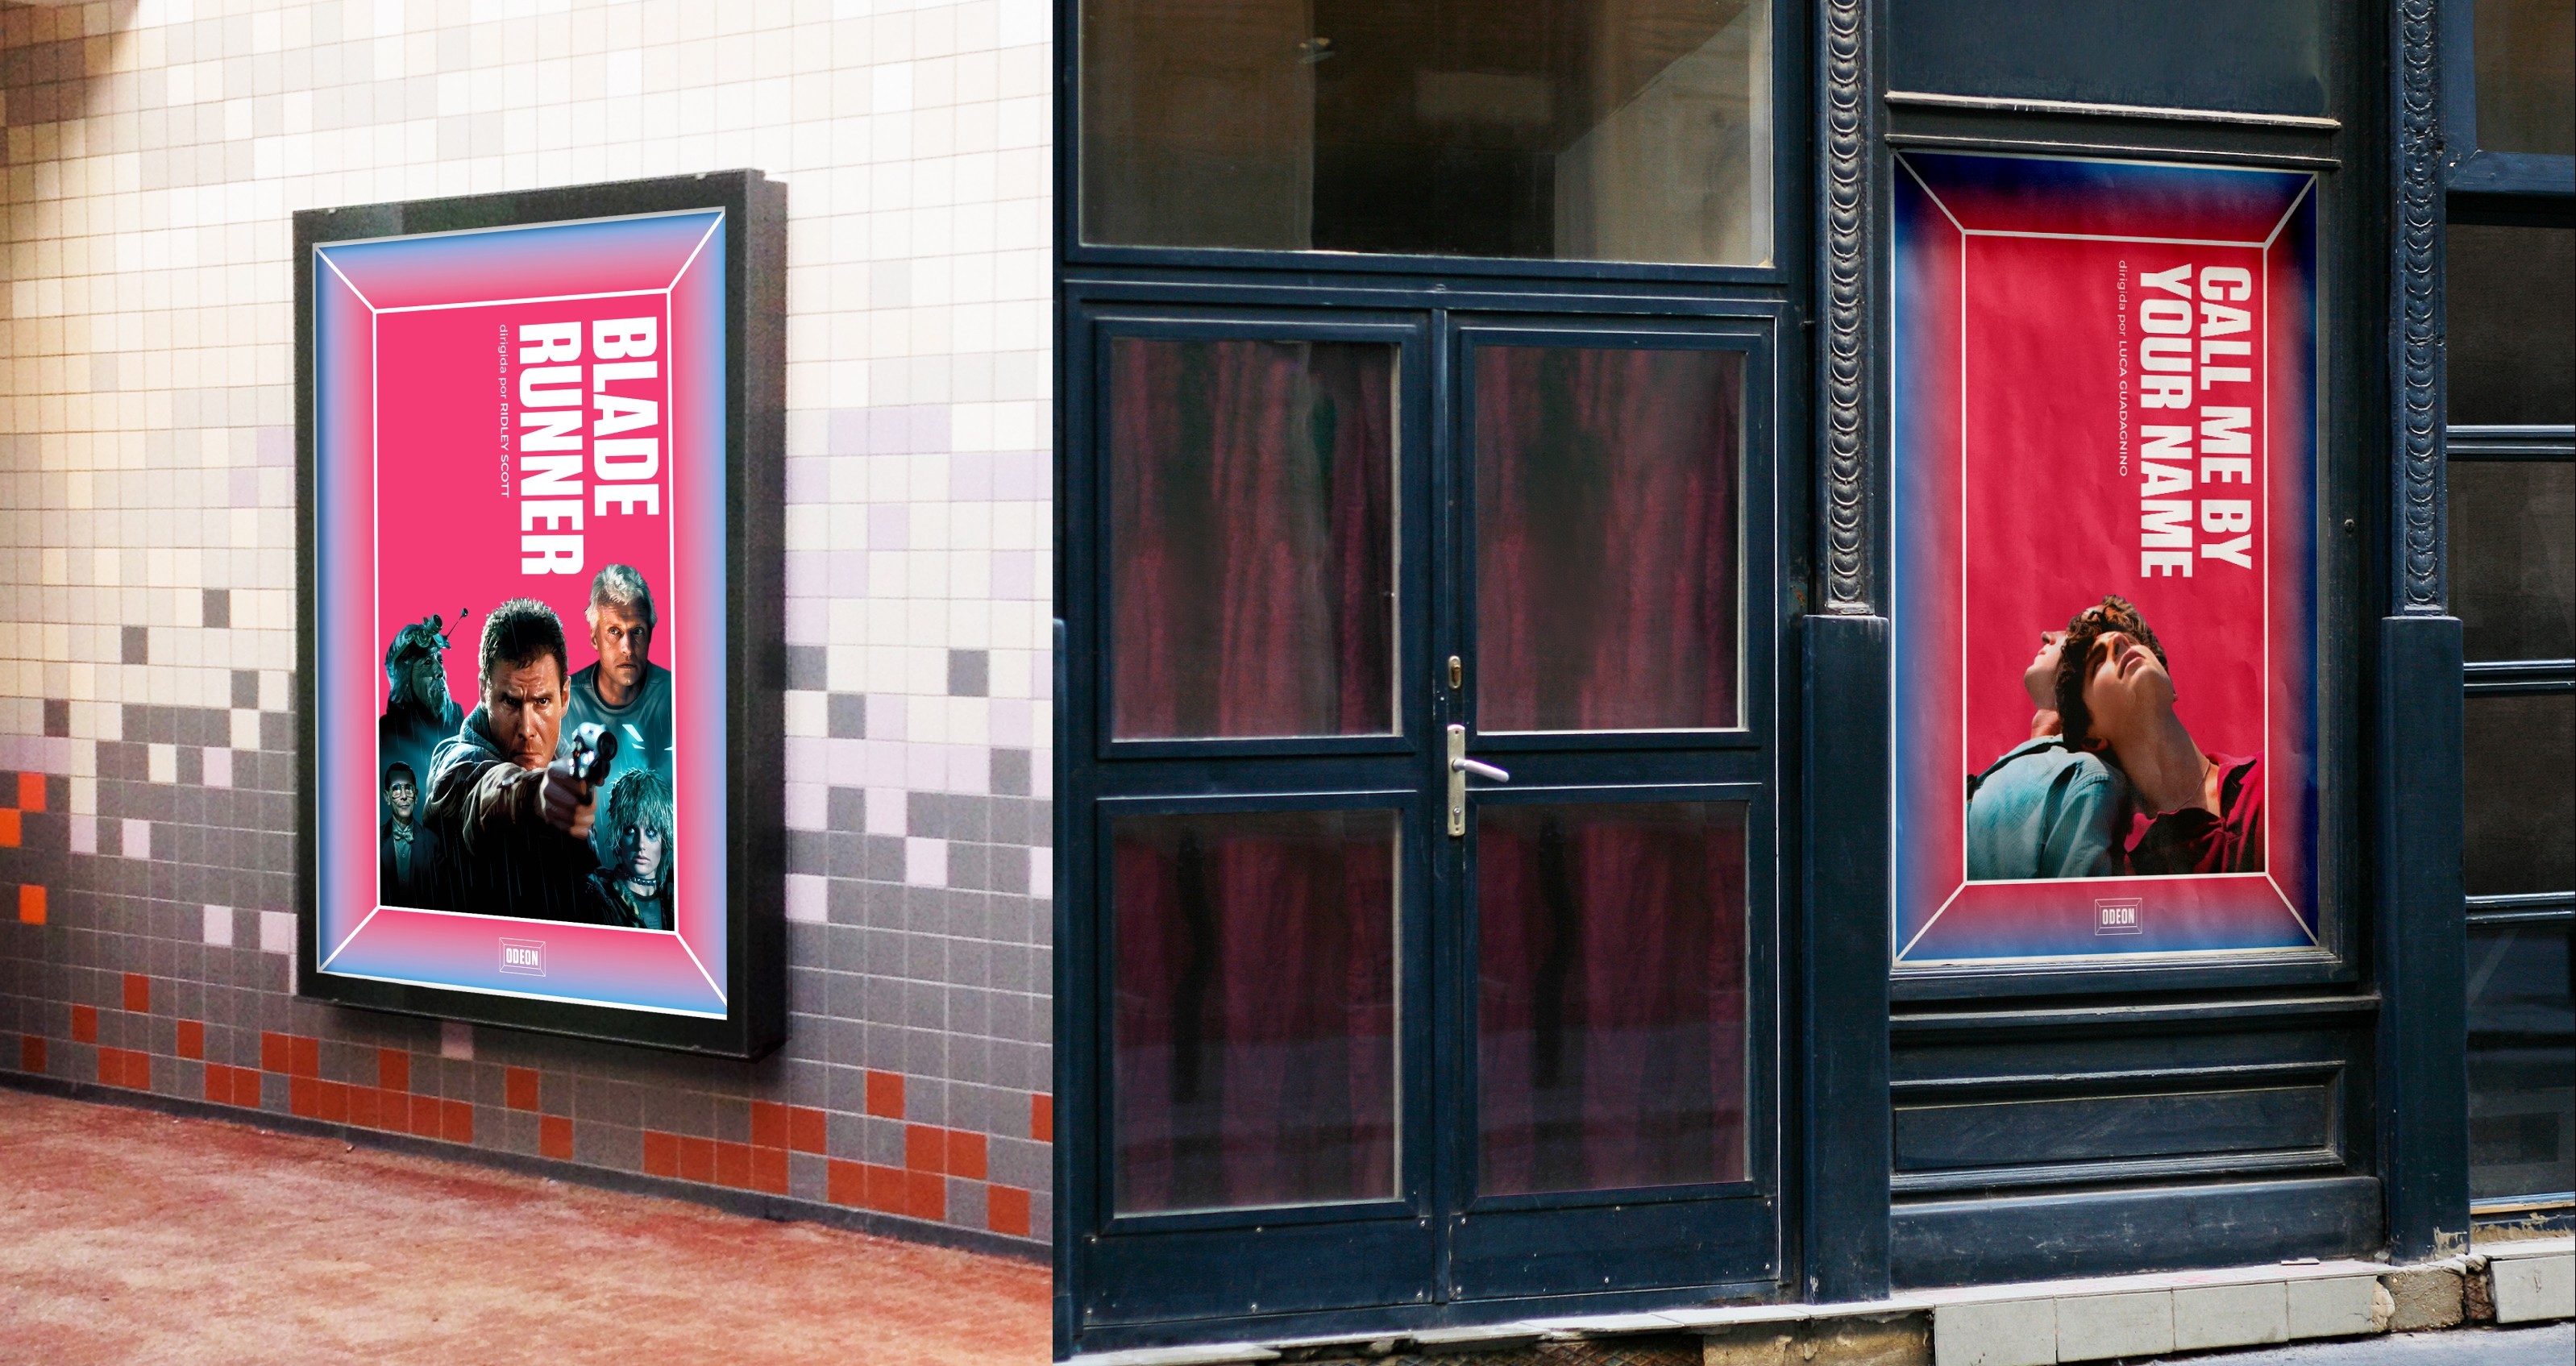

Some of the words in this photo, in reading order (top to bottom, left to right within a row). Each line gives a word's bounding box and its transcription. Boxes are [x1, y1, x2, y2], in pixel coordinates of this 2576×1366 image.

[2117, 260, 2128, 310] dirigida
[497, 324, 509, 374] dirigida
[2117, 314, 2125, 337] por
[2141, 264, 2192, 409] YOUR
[2200, 267, 2251, 390] CALL
[2119, 340, 2128, 377] LUCA
[498, 377, 507, 400] por
[500, 402, 509, 451] RIDLEY
[592, 317, 659, 516] BLADE
[2119, 380, 2128, 477] GUADAGNINO
[520, 322, 584, 574] RUNNER
[2201, 406, 2251, 484] ME
[501, 454, 509, 498] SCOTT
[2141, 426, 2192, 577] NAME
[2201, 500, 2251, 569] BY
[2102, 908, 2134, 924] ODEON
[506, 948, 538, 965] ODEON
